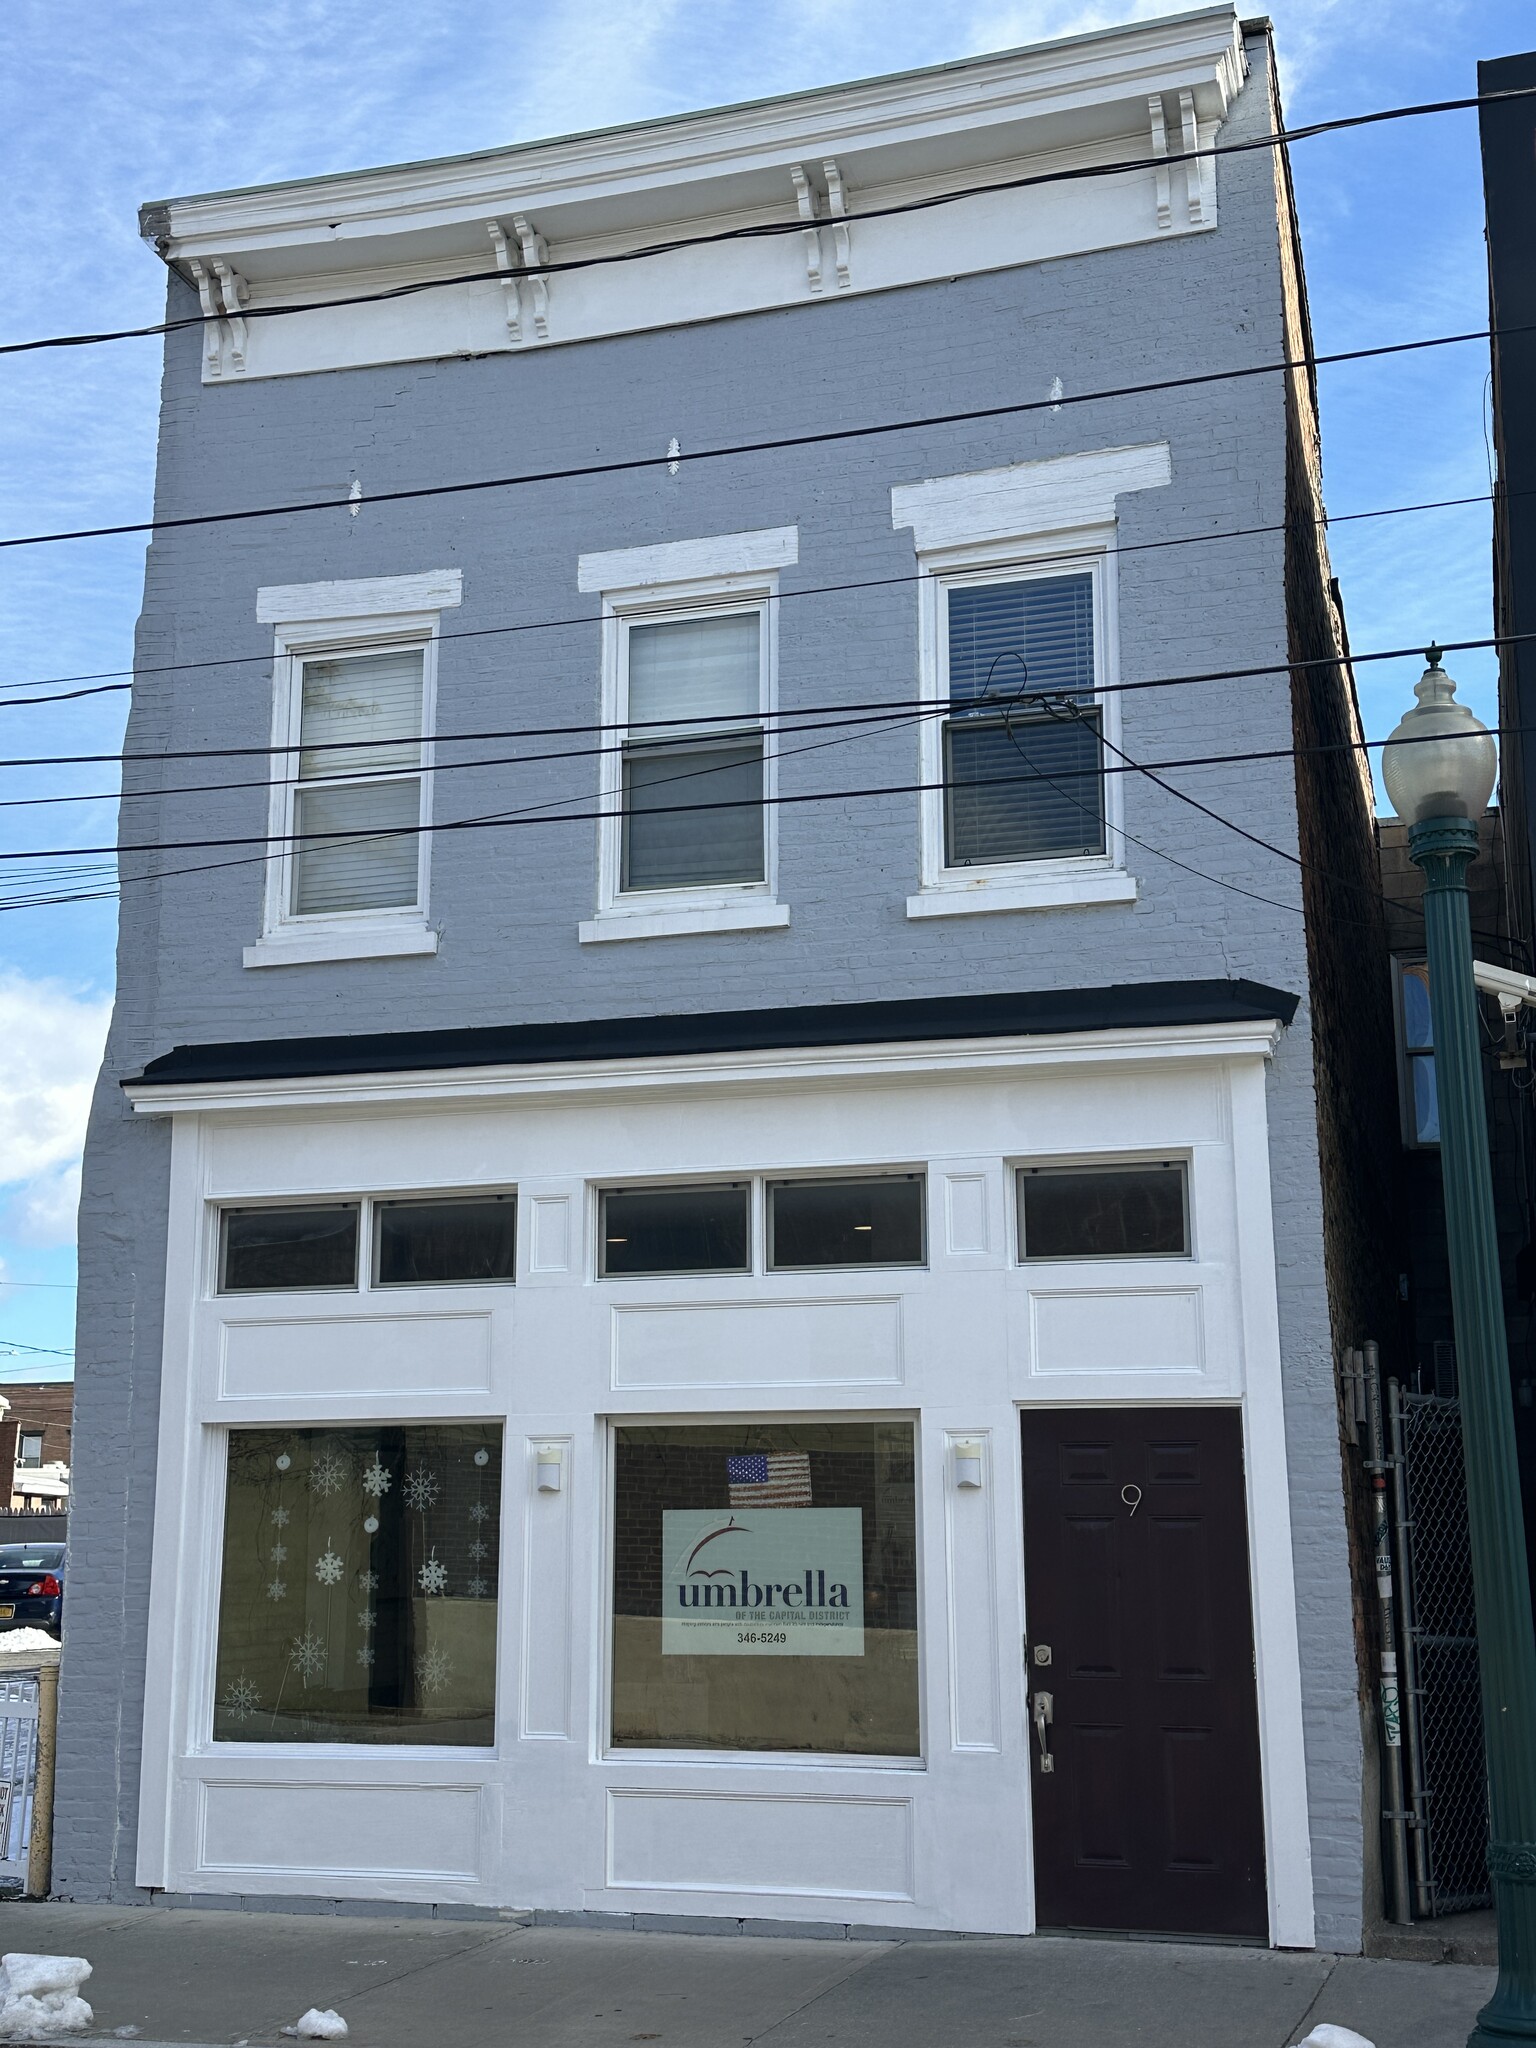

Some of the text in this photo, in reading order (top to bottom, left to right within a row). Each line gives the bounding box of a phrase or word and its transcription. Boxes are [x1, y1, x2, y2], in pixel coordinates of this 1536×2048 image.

[1121, 1484, 1142, 1517] 9
[677, 1569, 851, 1608] umbrella
[735, 1611, 850, 1620] OF THE CAPITAL DISTRICT
[737, 1632, 787, 1644] 346-5249
